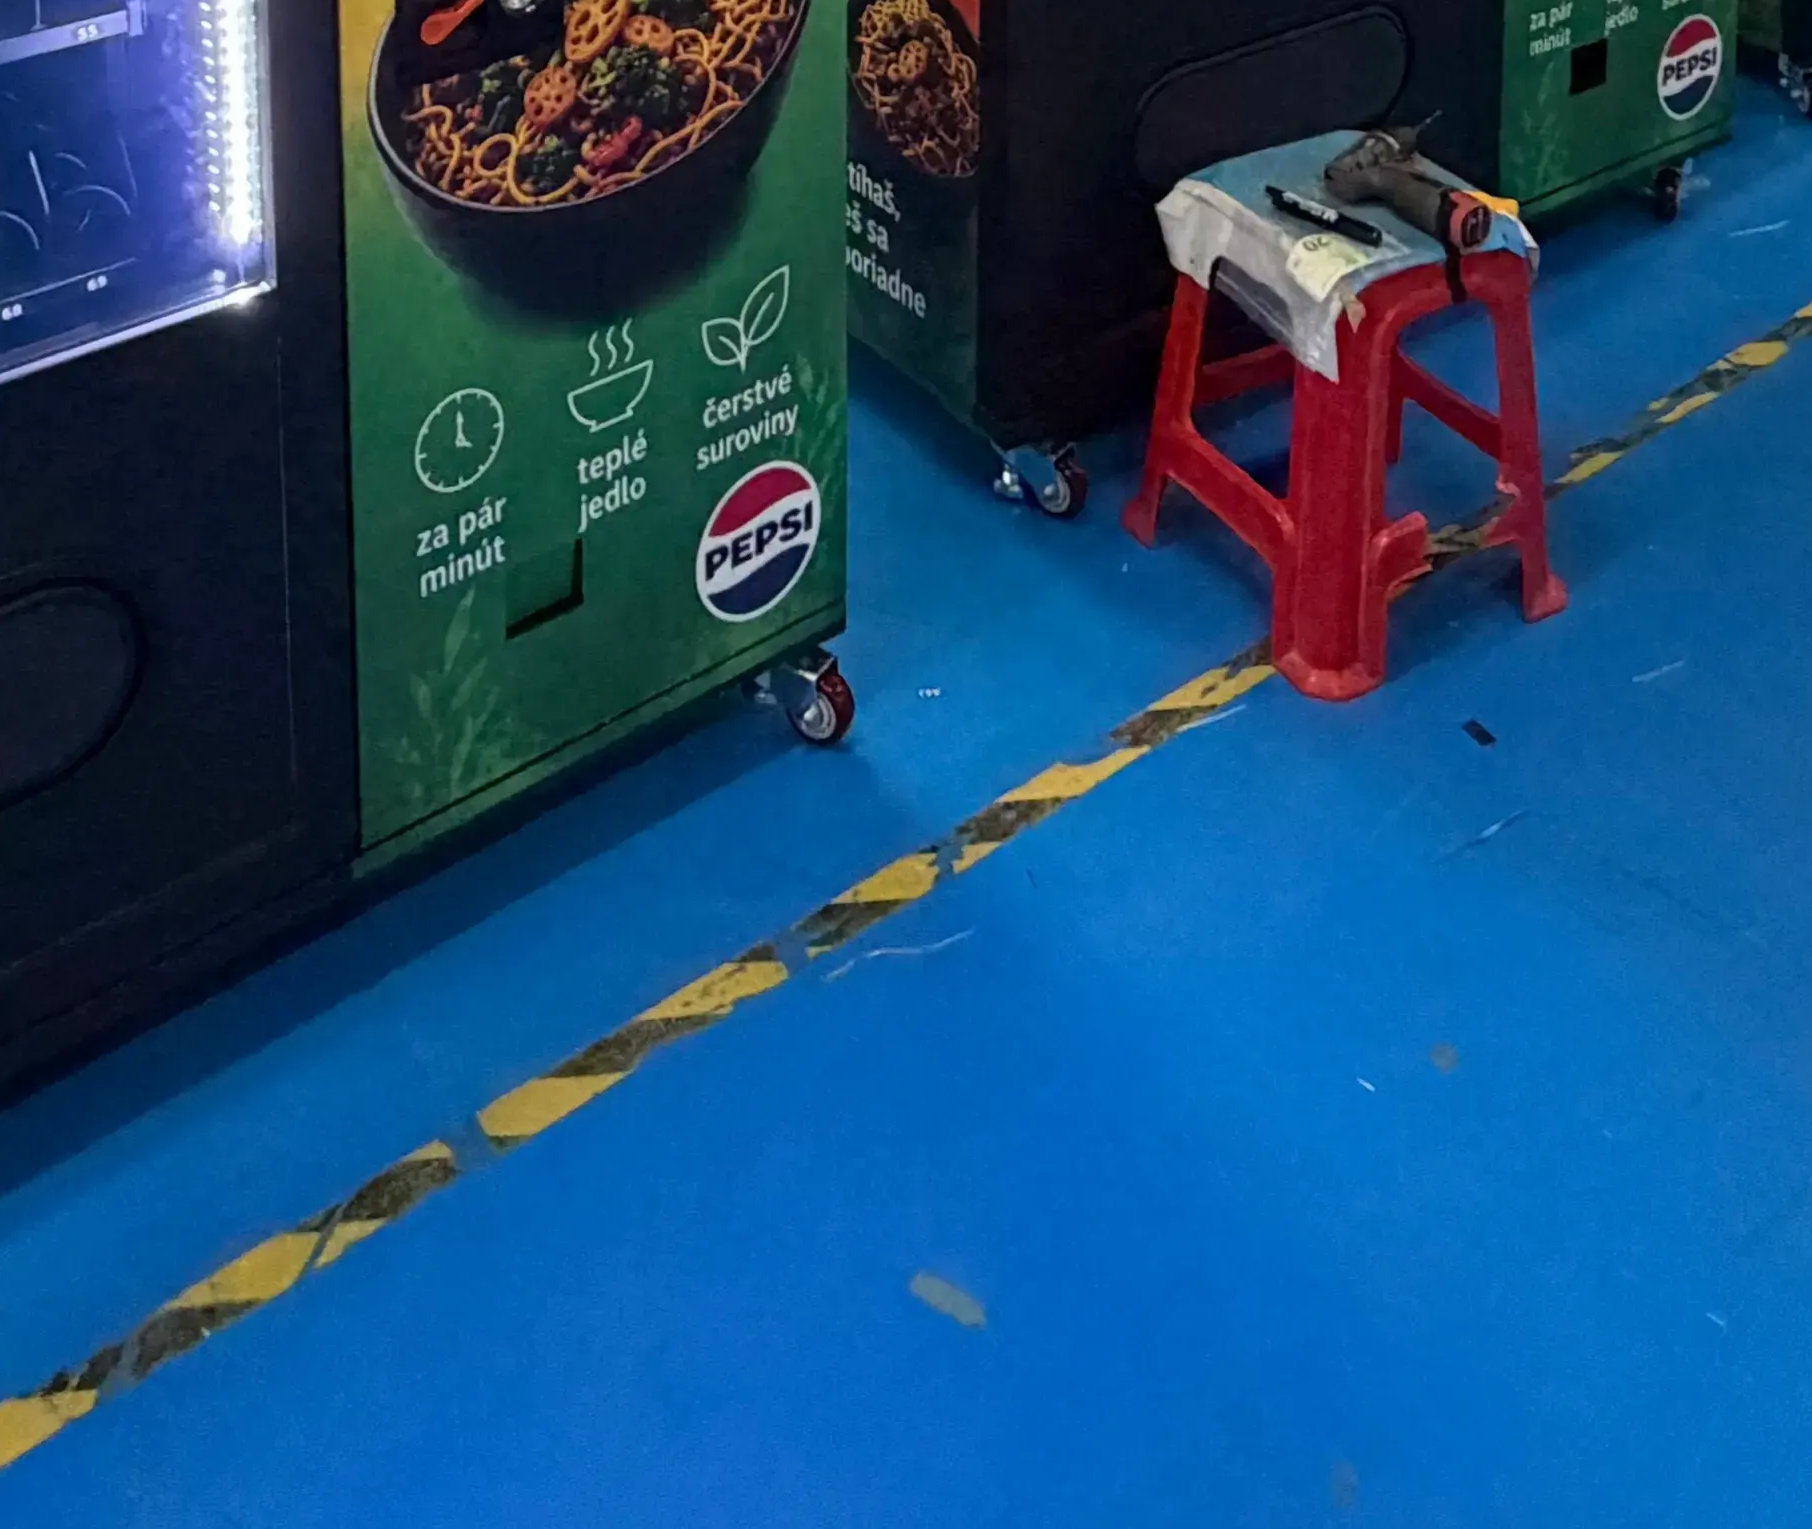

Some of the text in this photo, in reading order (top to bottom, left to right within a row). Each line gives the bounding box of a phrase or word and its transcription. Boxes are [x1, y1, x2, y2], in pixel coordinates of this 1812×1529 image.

[1661, 46, 1717, 86] PEPSI
[866, 219, 889, 253] sa
[702, 364, 792, 429] čerstvé
[577, 428, 648, 486] teplé
[696, 404, 799, 471] suroviny
[416, 494, 508, 557] za pár
[577, 477, 648, 534] jedlo
[418, 534, 507, 599] minút
[704, 501, 814, 583] PEPSI
